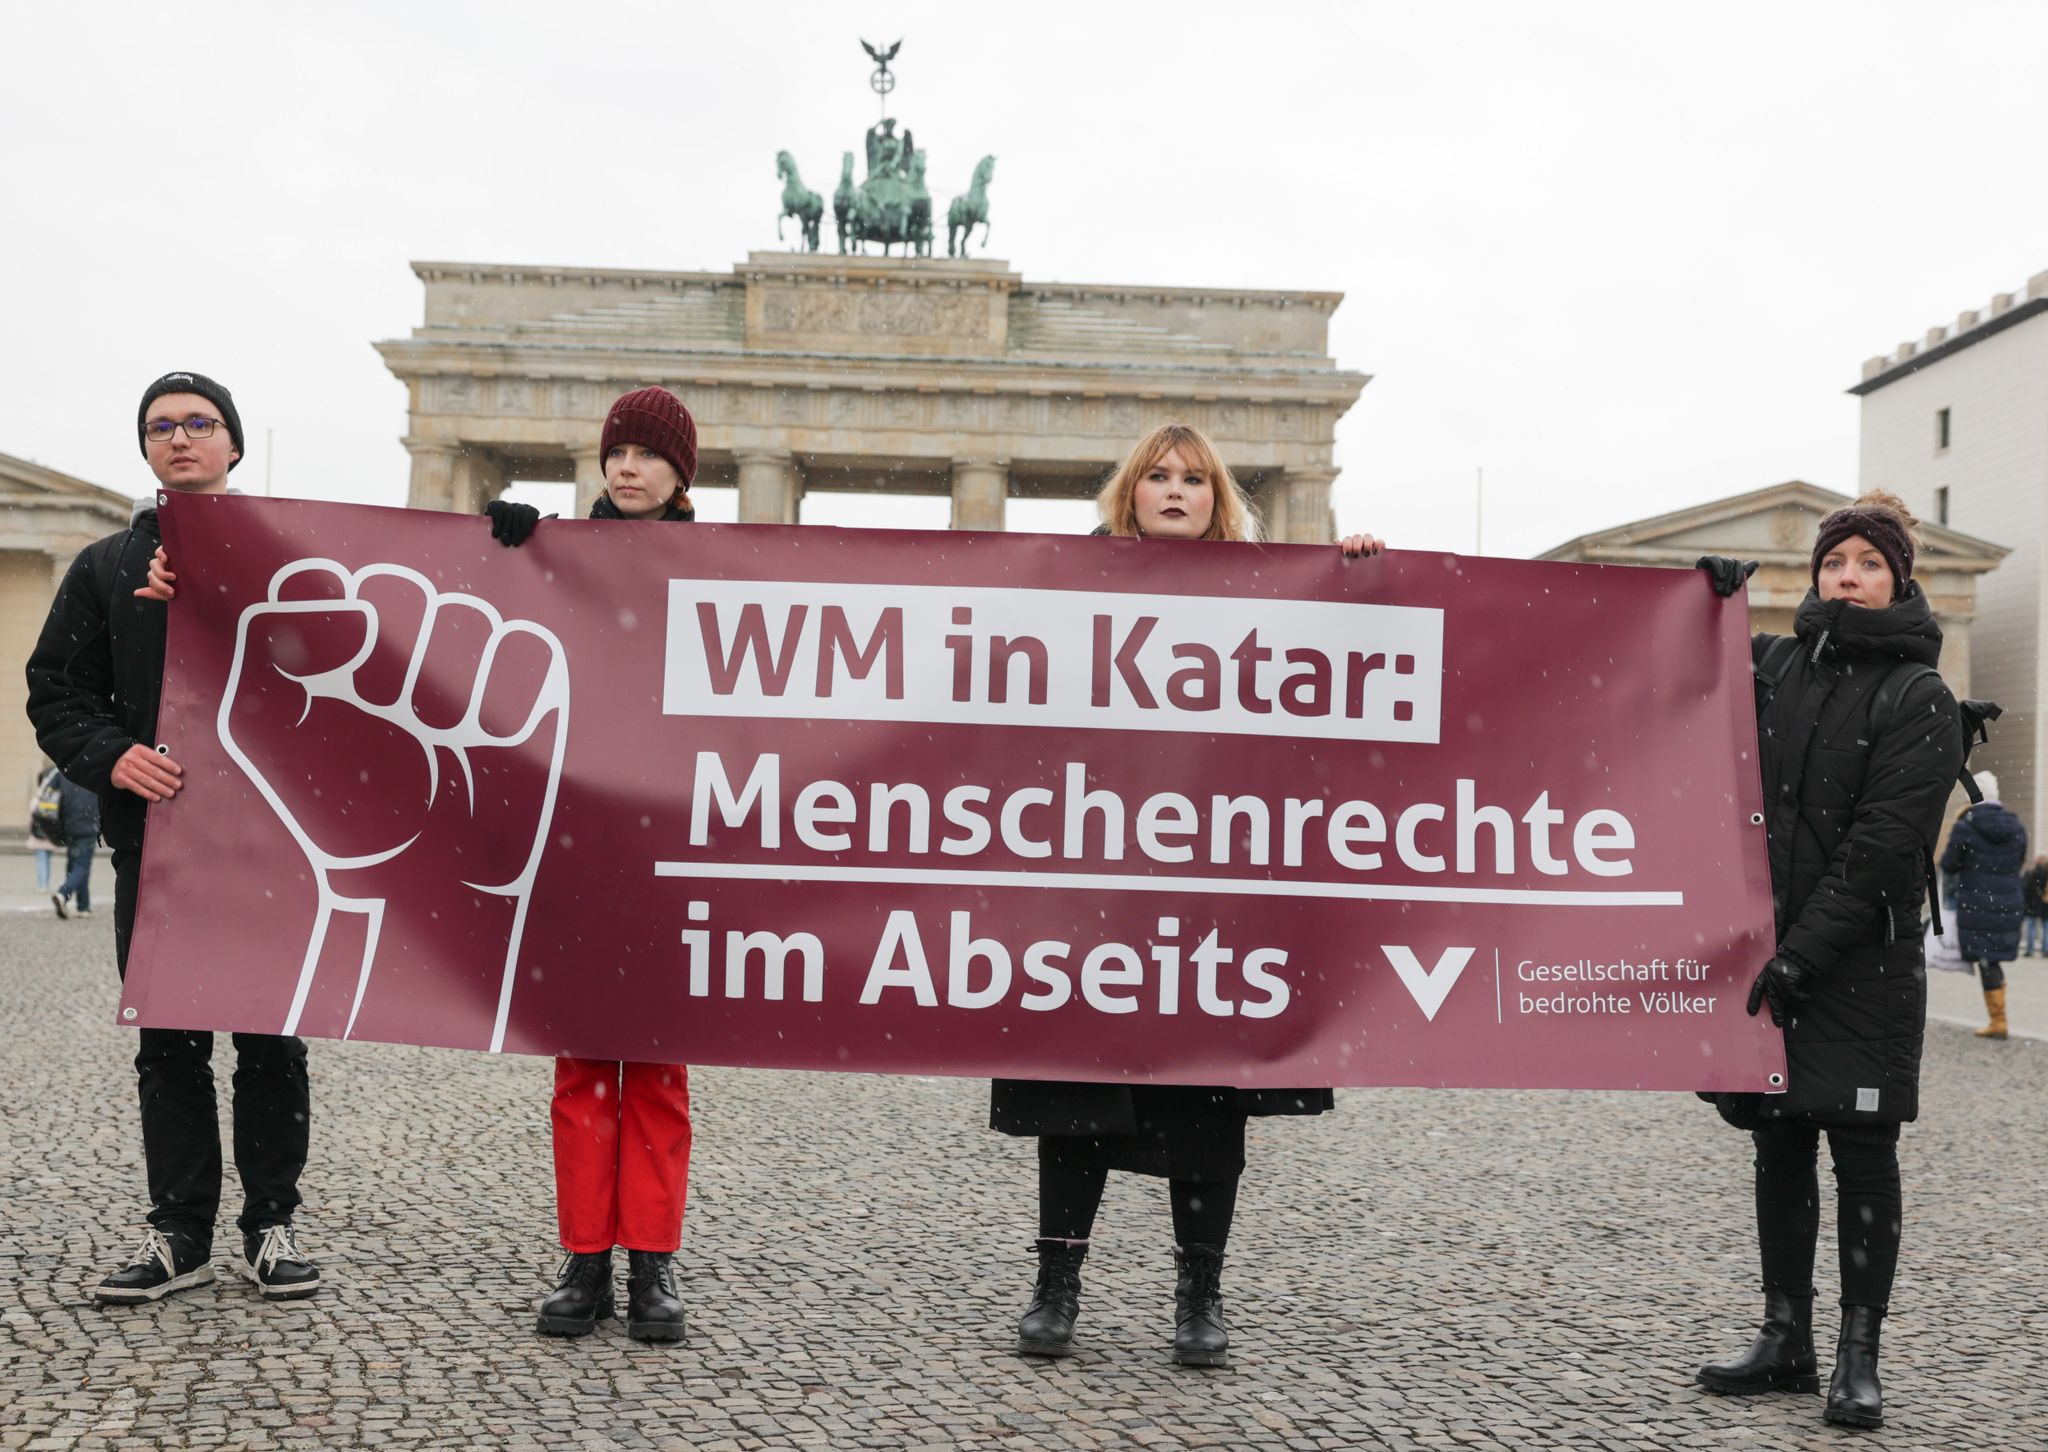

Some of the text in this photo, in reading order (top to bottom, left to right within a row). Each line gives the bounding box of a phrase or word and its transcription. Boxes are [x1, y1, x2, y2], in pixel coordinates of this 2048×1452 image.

[695, 602, 1415, 722] WM in Katar:
[689, 750, 1636, 878] Menschenrechte
[681, 900, 1290, 1019] im Abseits
[1517, 958, 1711, 982] Gesellschaft für
[1519, 991, 1717, 1014] bedrohte Völker
